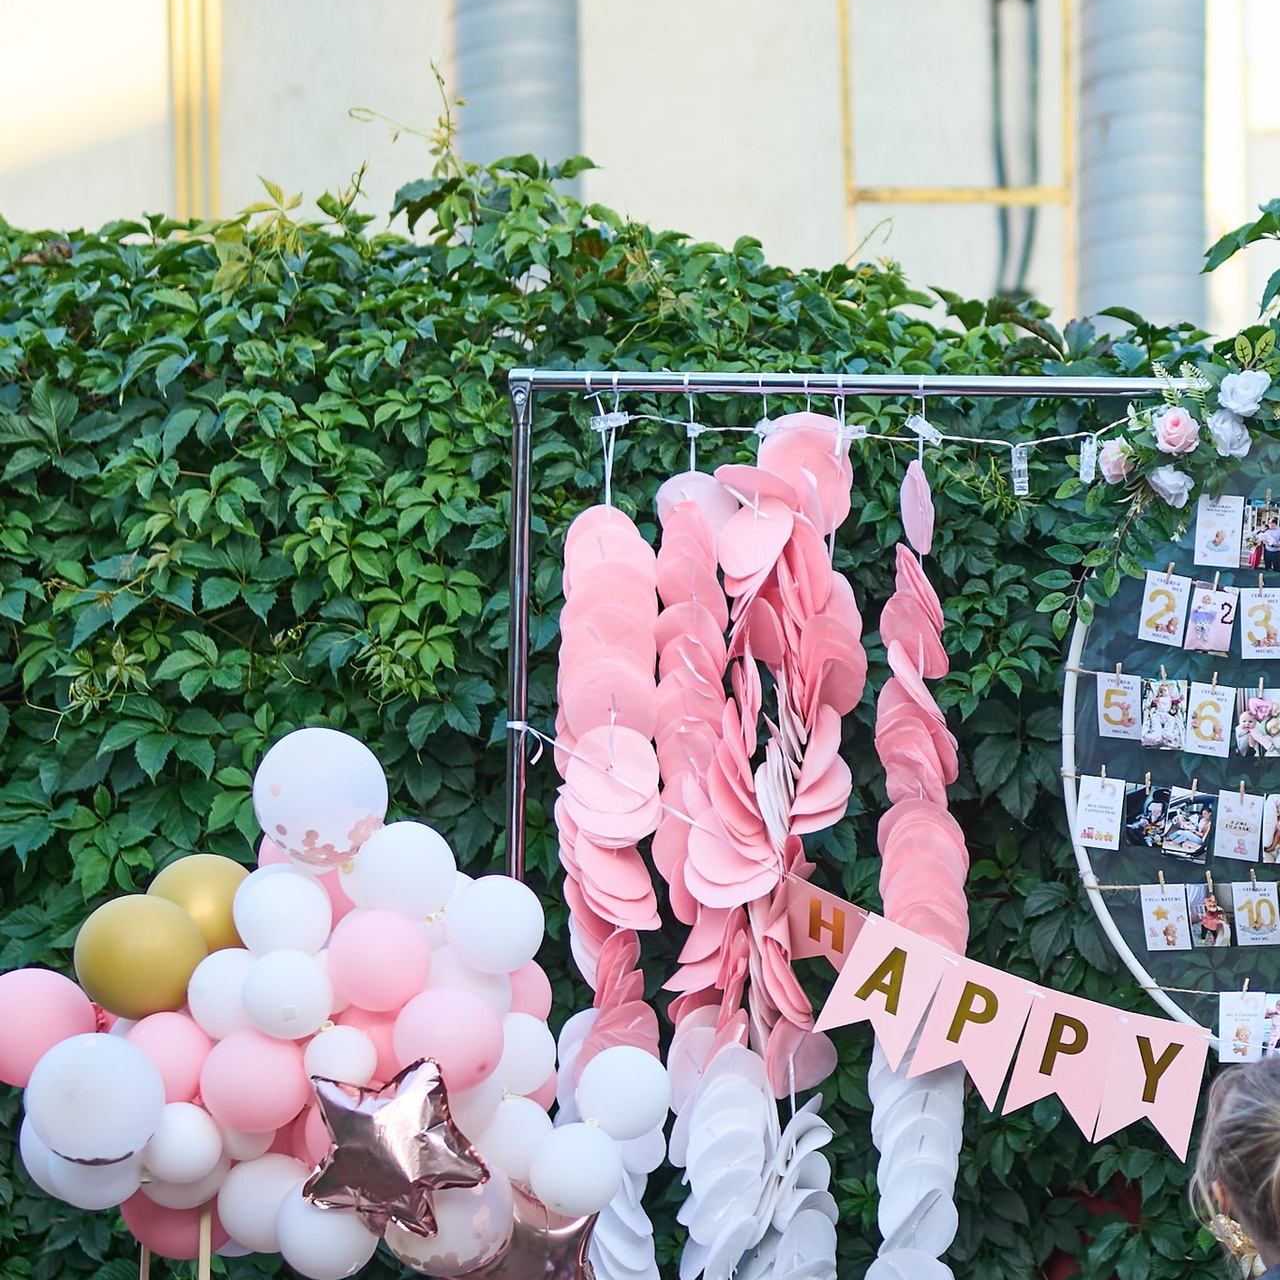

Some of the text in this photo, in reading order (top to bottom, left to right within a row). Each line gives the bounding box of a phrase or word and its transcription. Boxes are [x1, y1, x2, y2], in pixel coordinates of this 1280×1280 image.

[1145, 589, 1176, 628] 2
[1221, 602, 1233, 624] 2
[1247, 604, 1273, 644] 3
[1103, 688, 1130, 725] 5
[1193, 700, 1221, 741] 6
[1237, 898, 1276, 928] 10
[808, 898, 1184, 1103] HAPPY
